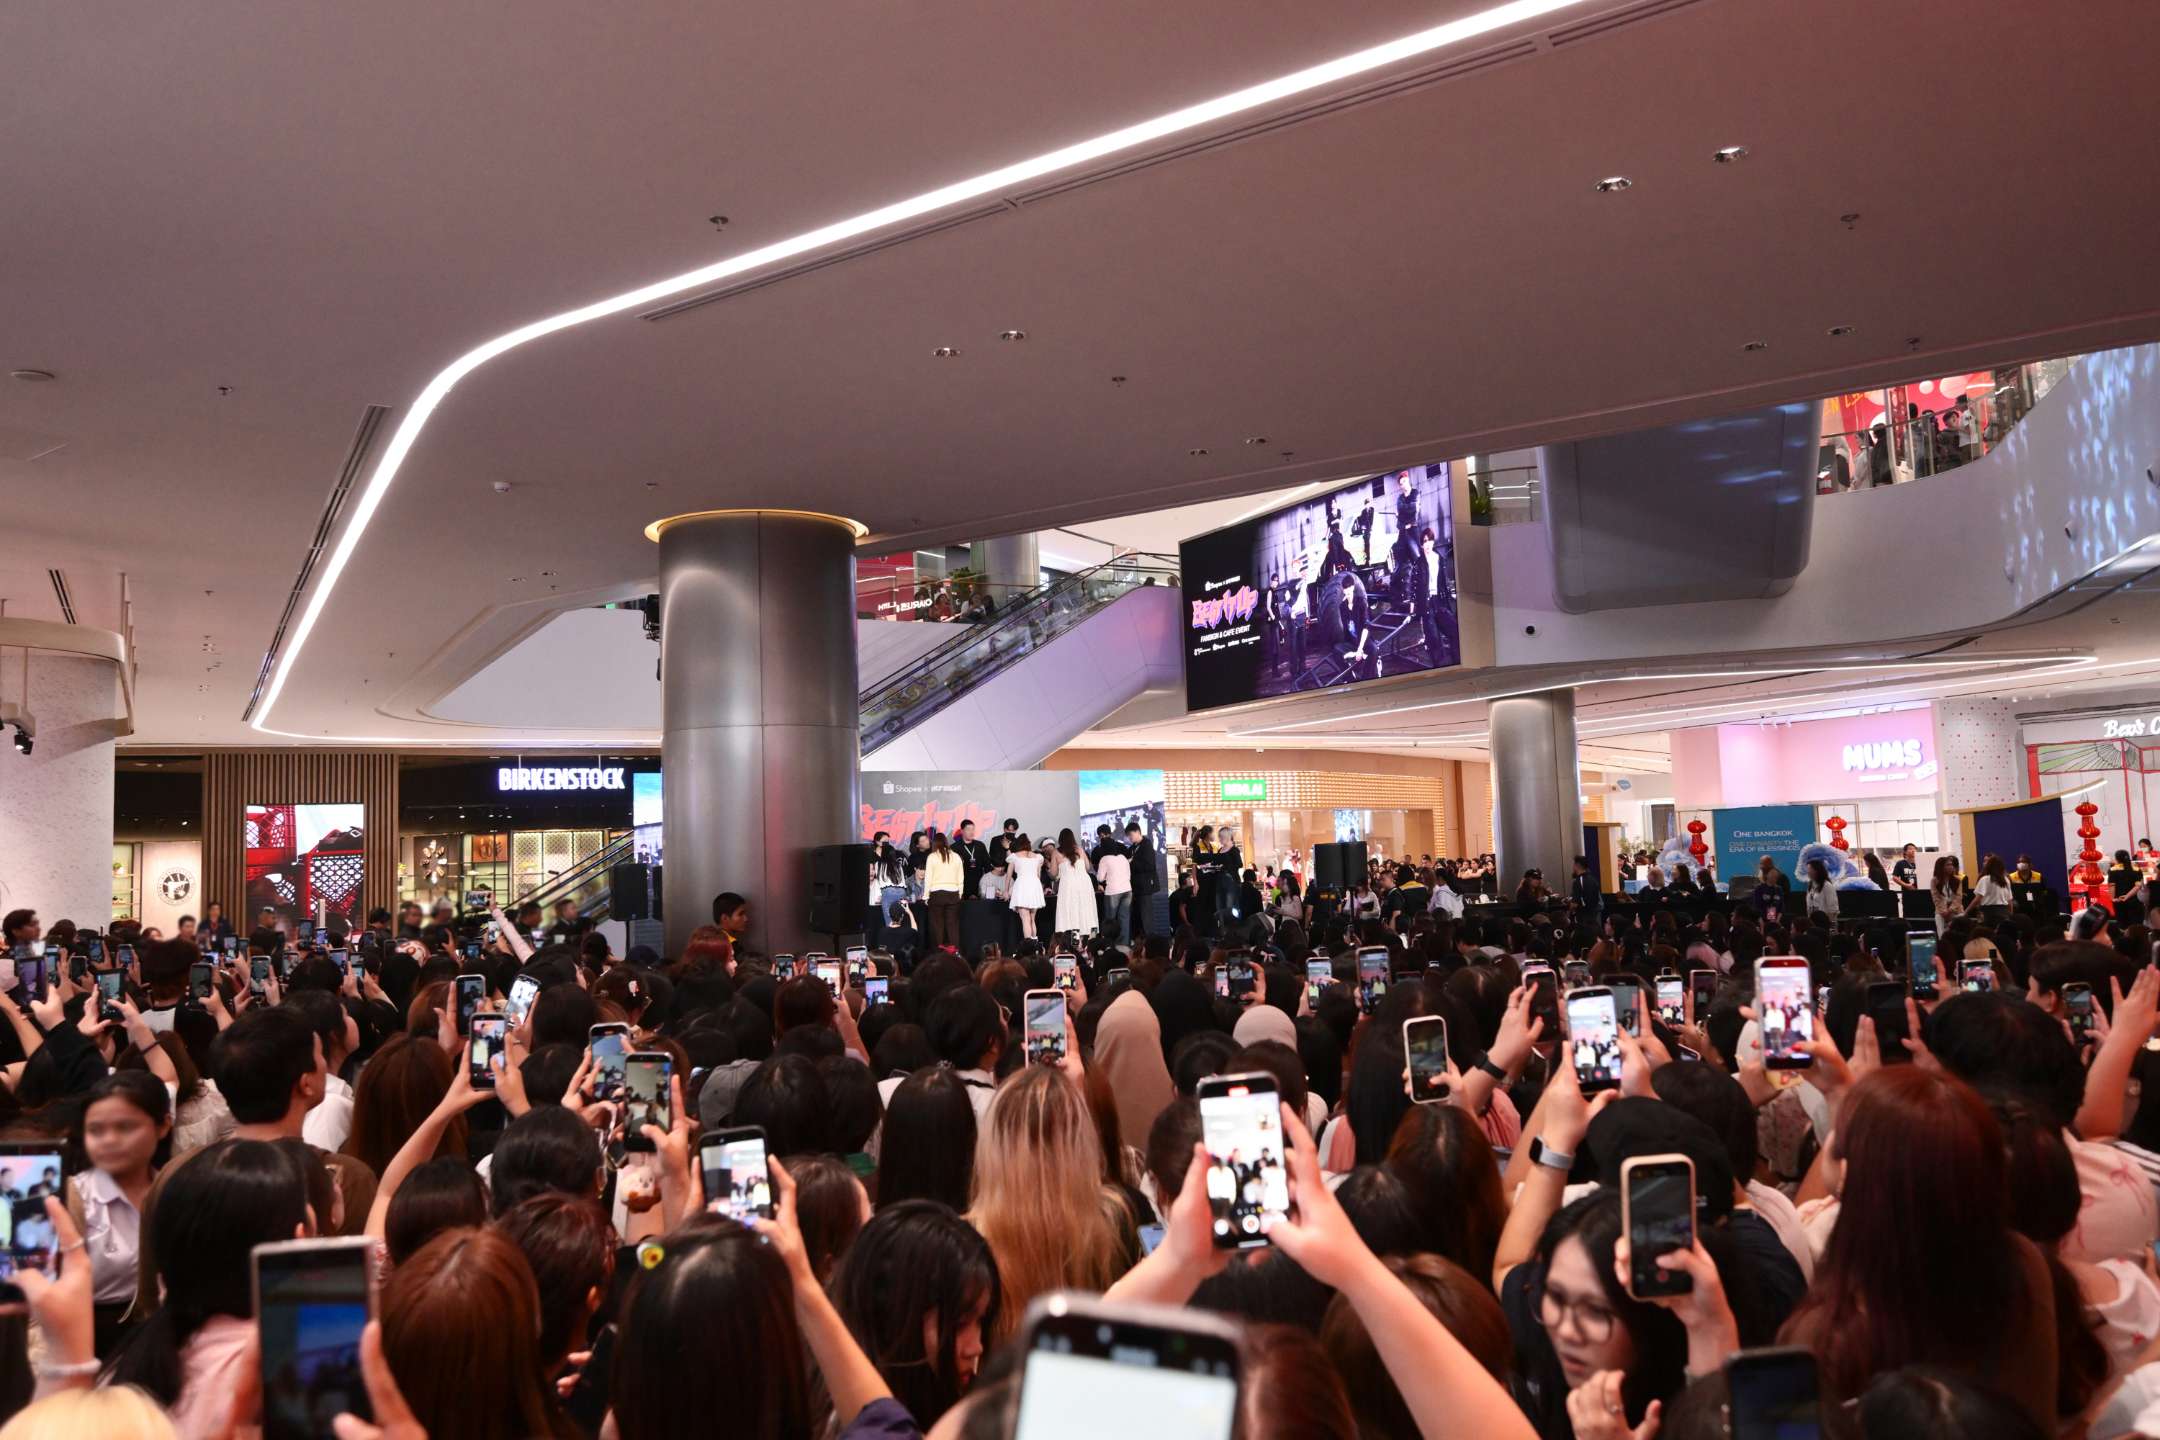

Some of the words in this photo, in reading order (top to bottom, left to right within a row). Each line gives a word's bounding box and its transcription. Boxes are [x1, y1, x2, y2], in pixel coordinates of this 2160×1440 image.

[1843, 738, 1923, 771] MUMS
[498, 767, 625, 790] BIRKENSTOCK
[895, 784, 922, 794] Shopee
[1754, 830, 1793, 838] BANGKOK
